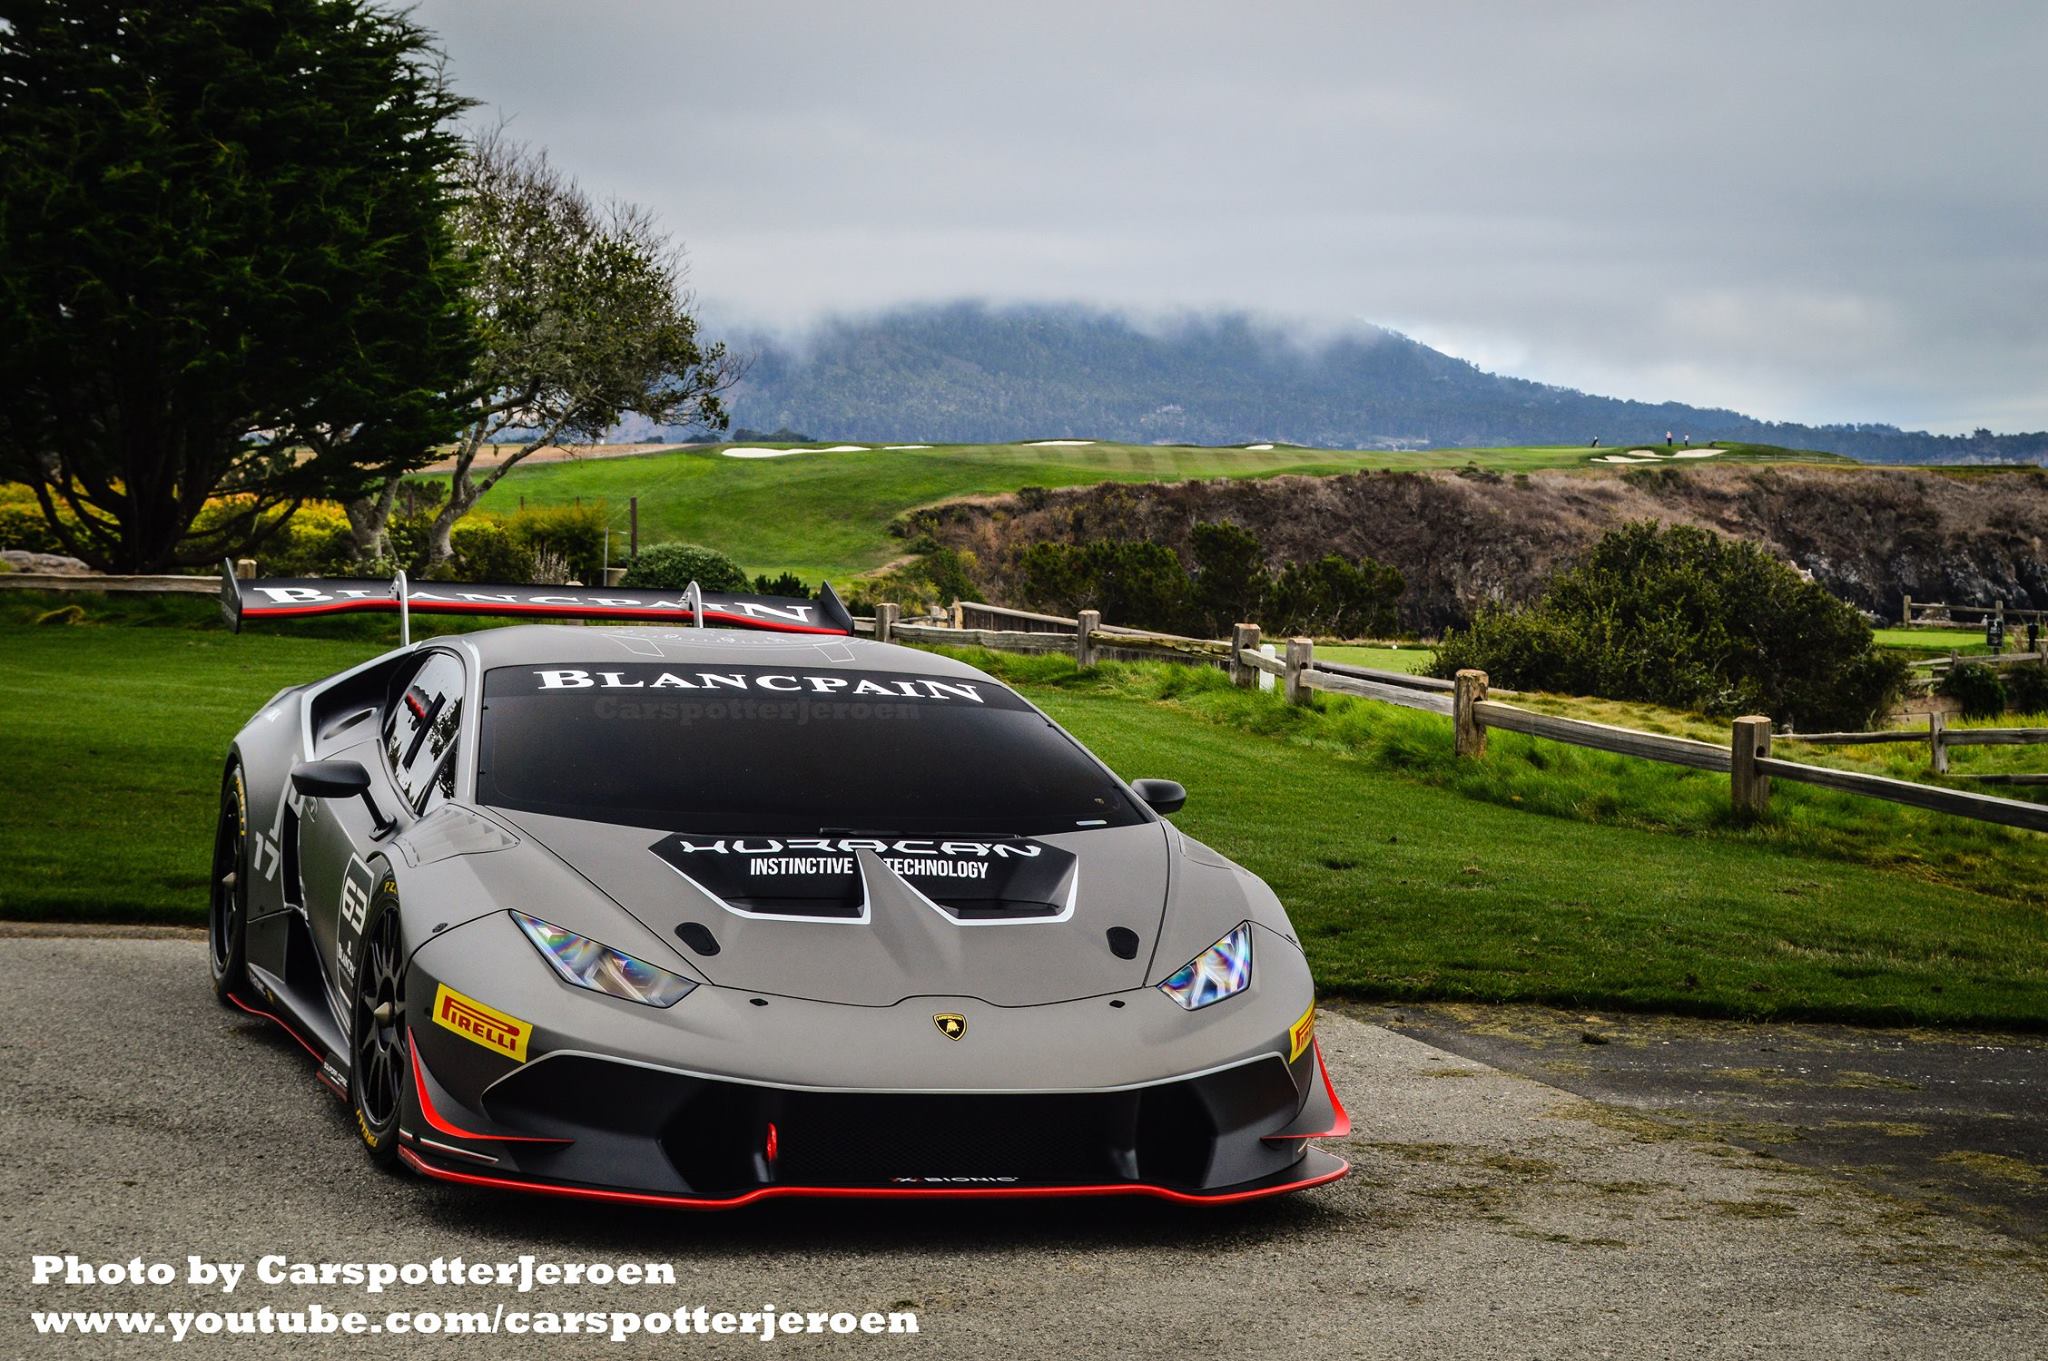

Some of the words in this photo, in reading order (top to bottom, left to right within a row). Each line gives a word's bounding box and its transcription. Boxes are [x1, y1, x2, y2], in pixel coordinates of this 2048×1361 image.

[533, 669, 985, 703] BLANCPAIN
[750, 857, 854, 876] INSTINCTIVE
[884, 858, 989, 879] TECHNOLOGY
[342, 876, 368, 936] 63
[441, 995, 521, 1052] PIRELLI
